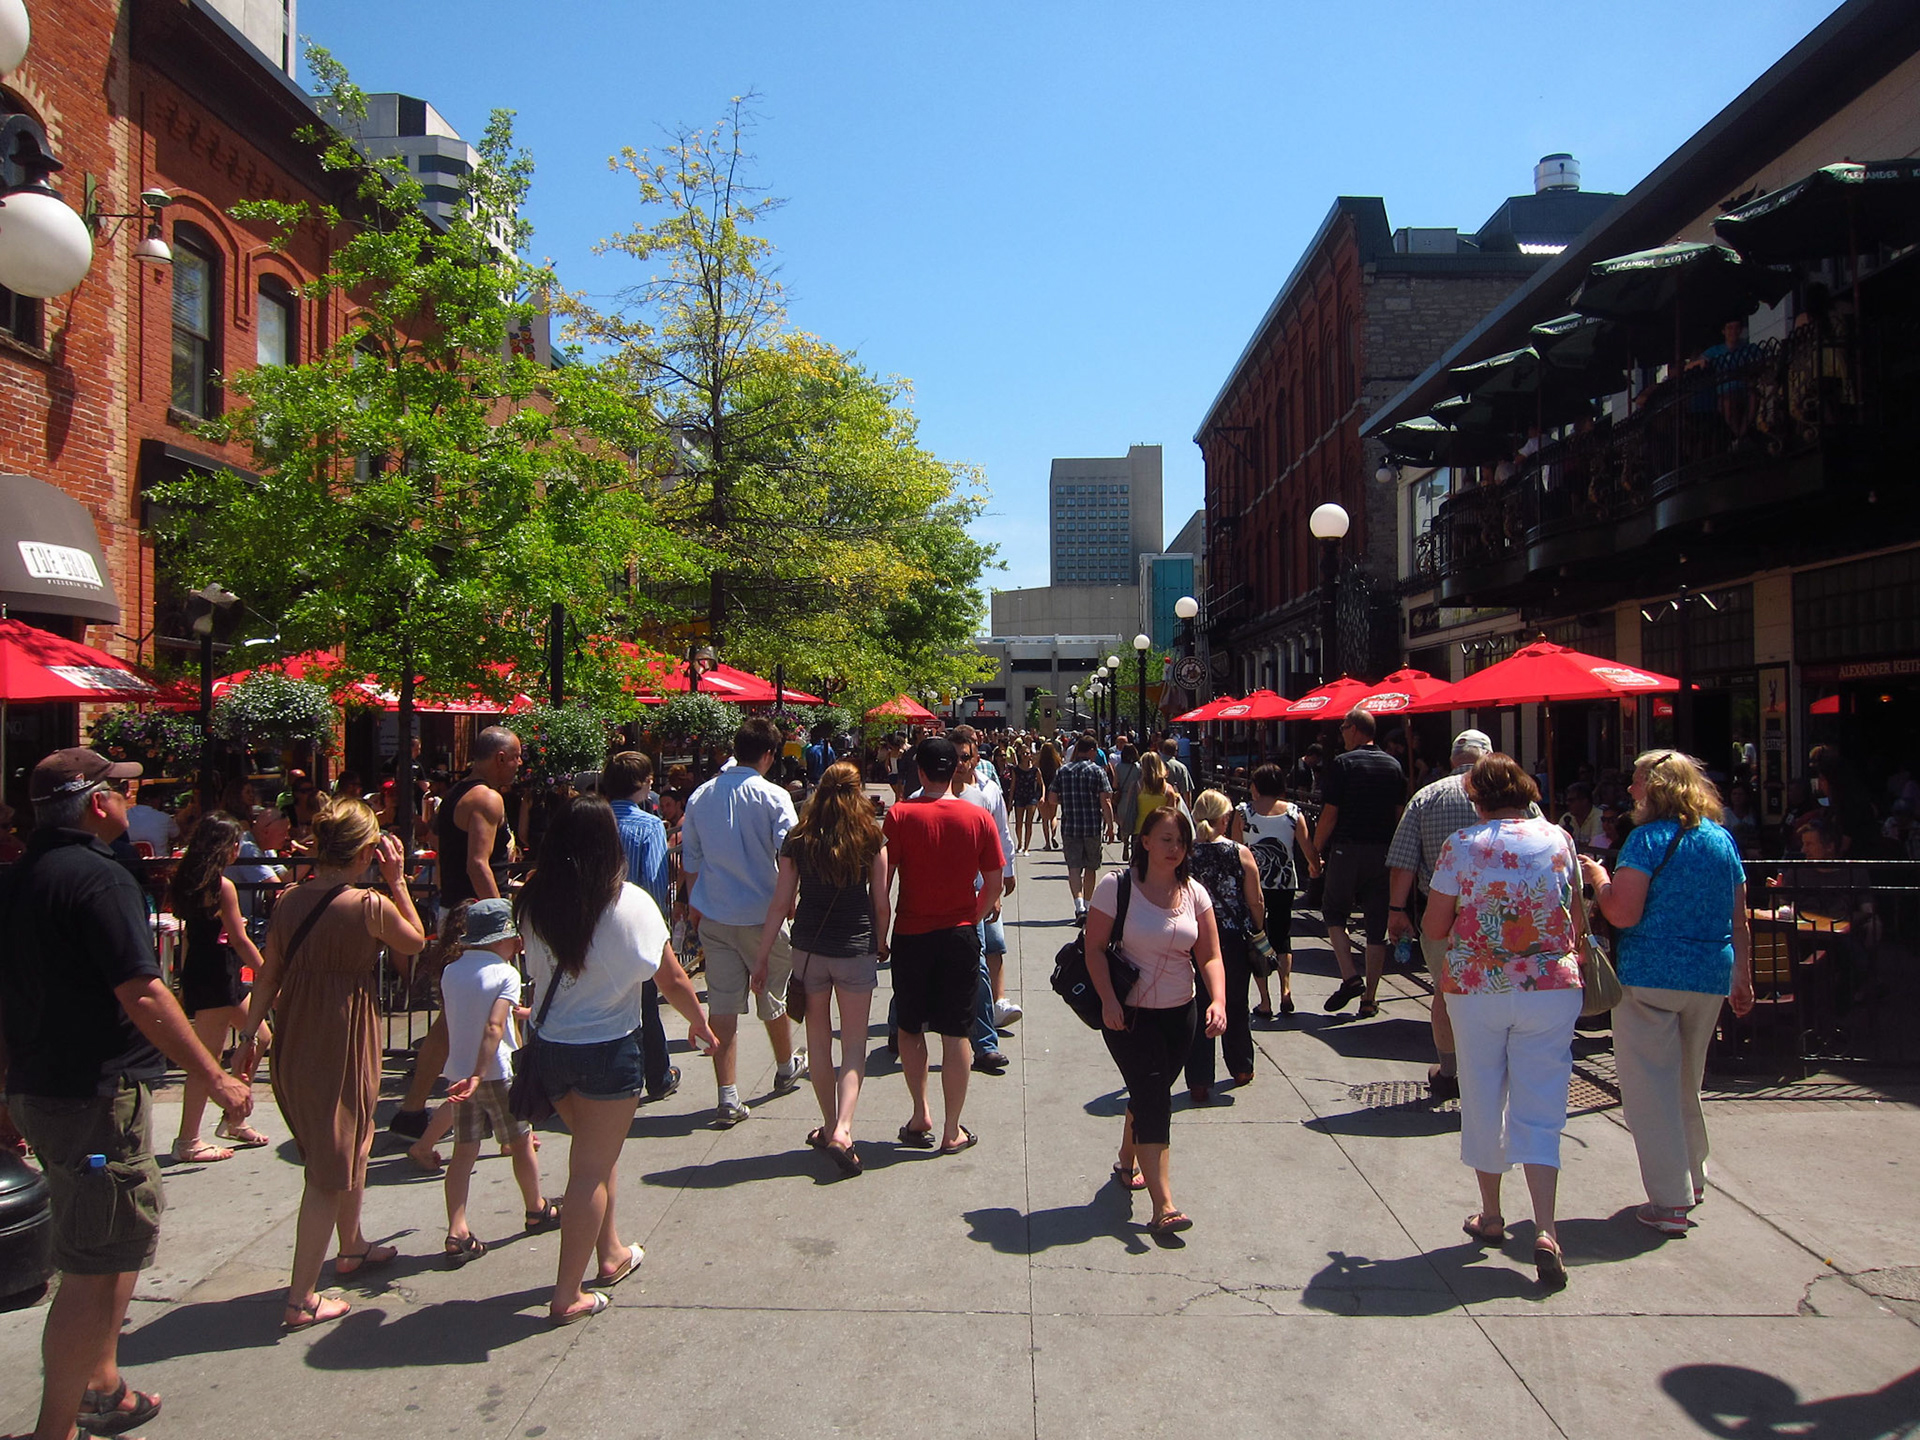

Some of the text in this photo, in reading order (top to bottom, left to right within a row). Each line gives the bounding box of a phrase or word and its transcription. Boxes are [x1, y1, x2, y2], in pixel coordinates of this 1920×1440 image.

[1605, 250, 1698, 273] ALEXANDER KEITH'S
[25, 545, 60, 575] THE
[1839, 662, 1892, 679] ALEXANDER
